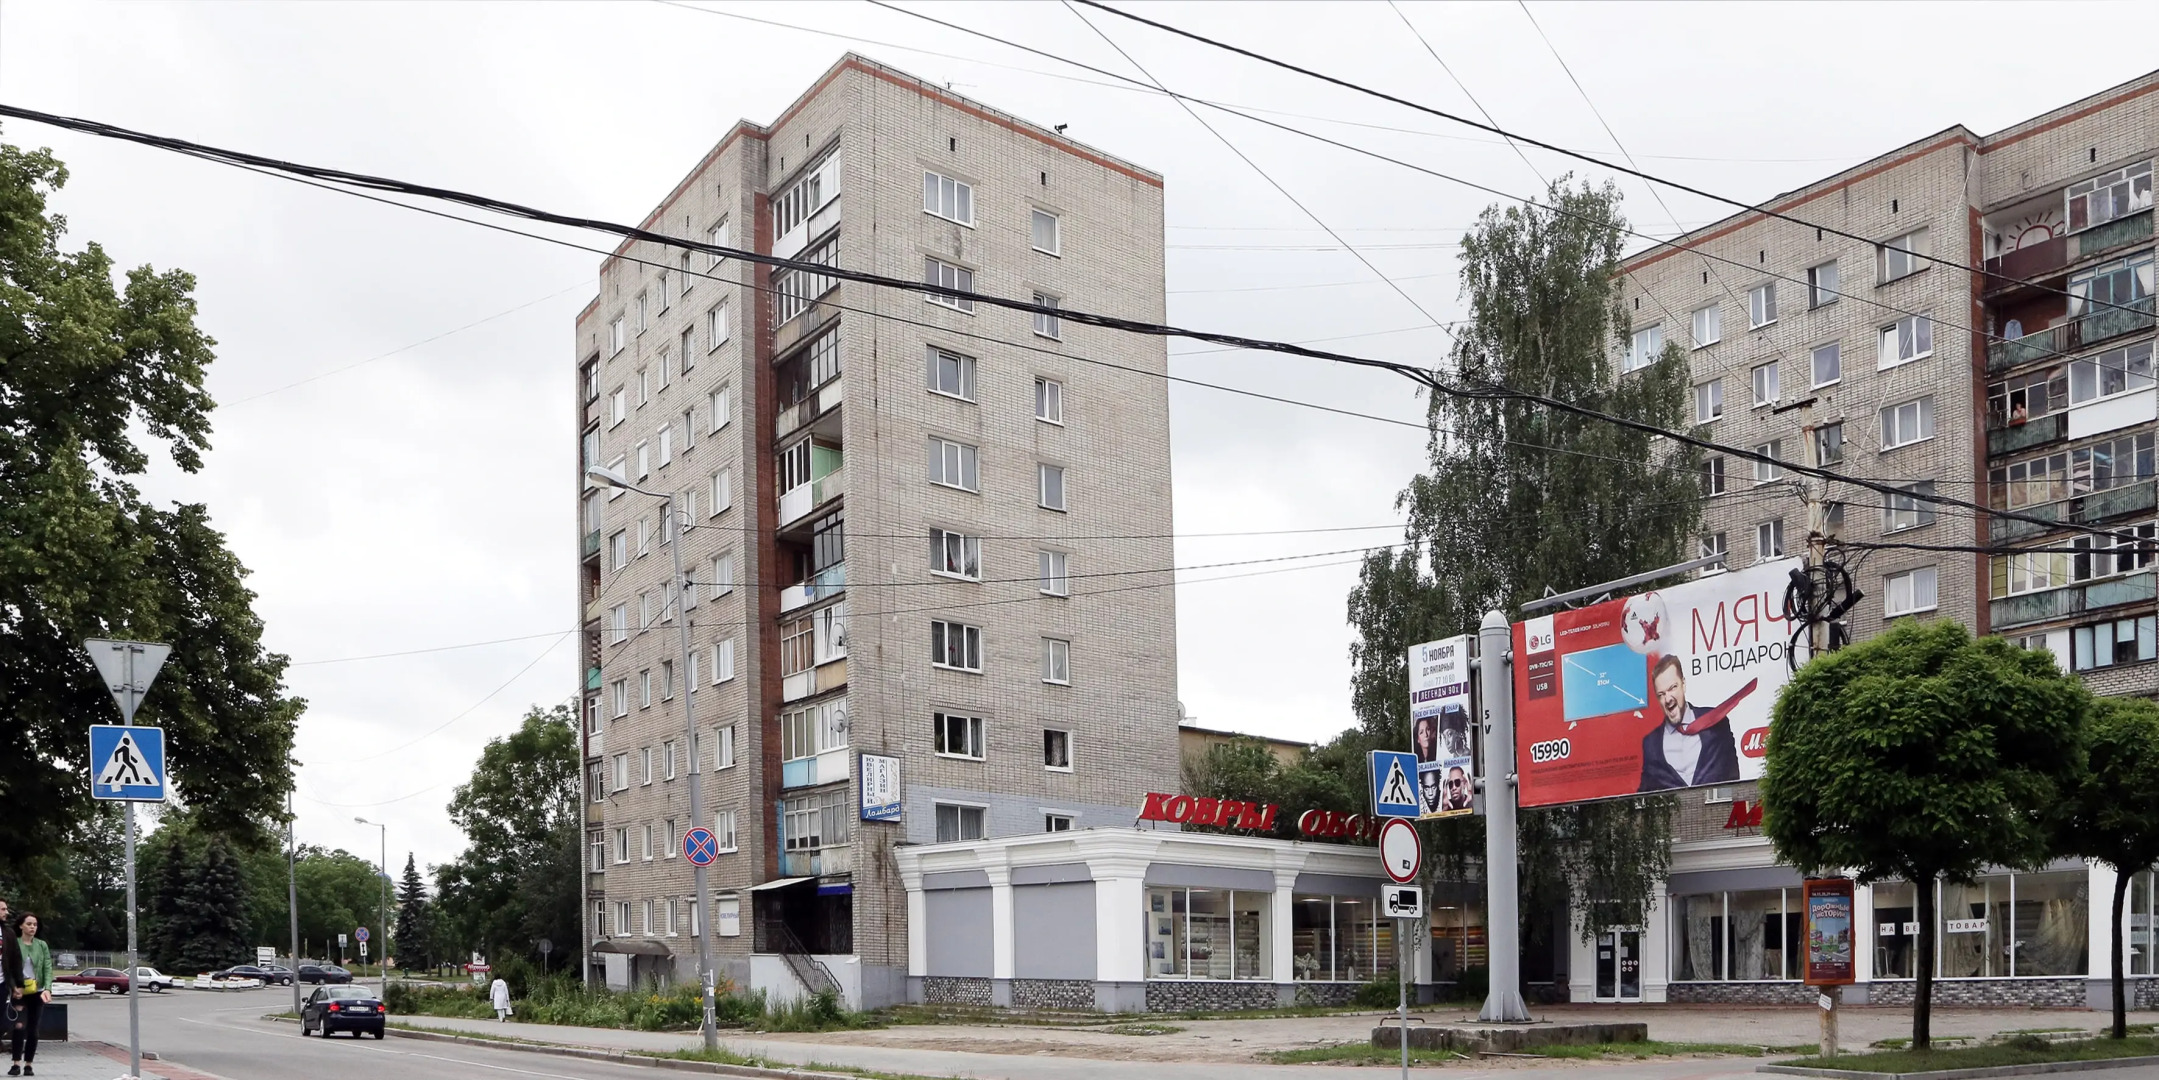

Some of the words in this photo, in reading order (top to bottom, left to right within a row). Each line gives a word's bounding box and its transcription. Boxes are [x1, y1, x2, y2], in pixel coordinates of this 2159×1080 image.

[1691, 591, 1792, 655] МЯЧ
[1540, 634, 1552, 646] LG
[1422, 646, 1428, 663] 5
[1428, 645, 1455, 662] НОЯБРЯ
[1692, 658, 1702, 676] В
[1536, 682, 1548, 691] USB
[1531, 740, 1569, 761] 15990
[865, 805, 900, 819] Ломбард
[1139, 792, 1279, 831] КОВРЫ
[1949, 921, 1986, 930] ТОВАР
